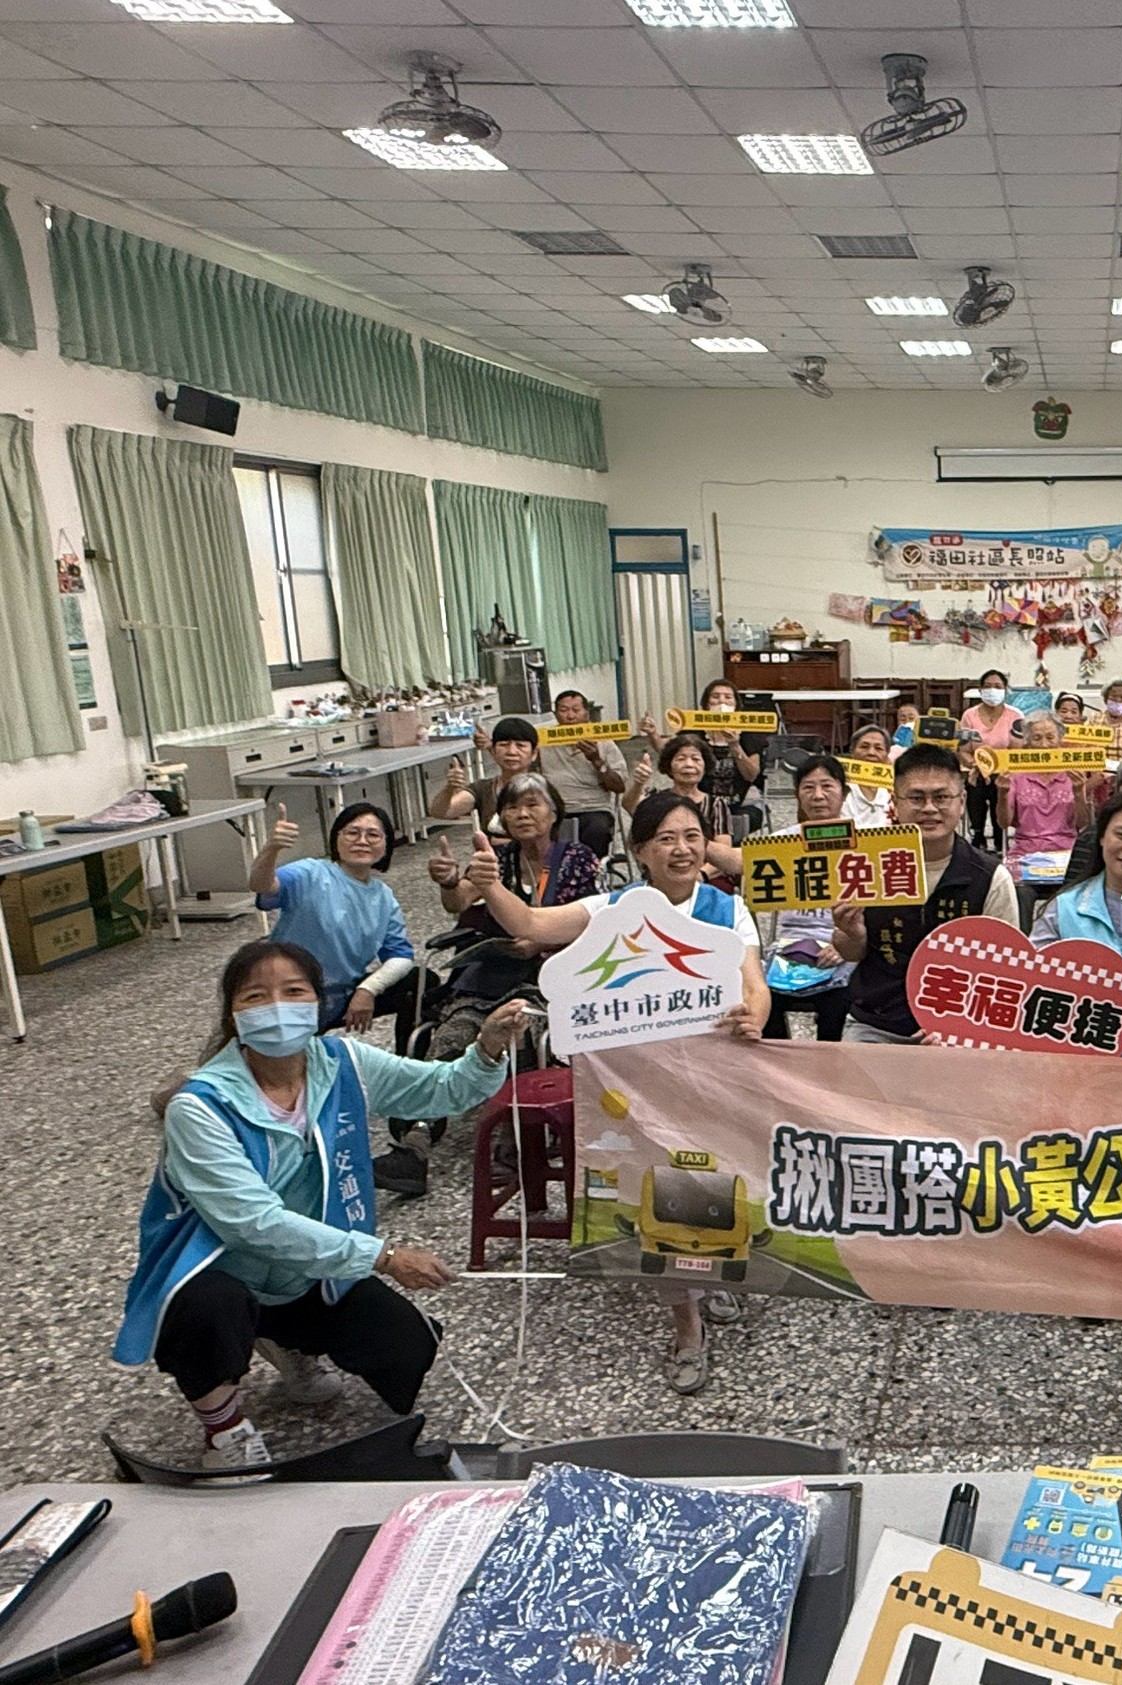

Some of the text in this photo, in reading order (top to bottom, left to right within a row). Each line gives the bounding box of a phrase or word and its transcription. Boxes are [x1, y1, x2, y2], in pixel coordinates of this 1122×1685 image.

[929, 547, 1065, 567] 福田社區長照站
[751, 849, 919, 903] 全程免費
[571, 985, 724, 1027] 臺中市政府
[574, 1011, 727, 1041] TAICHUNG CITY GOVERNMENT
[679, 1152, 707, 1164] TAXI
[334, 1149, 366, 1228] 交通局
